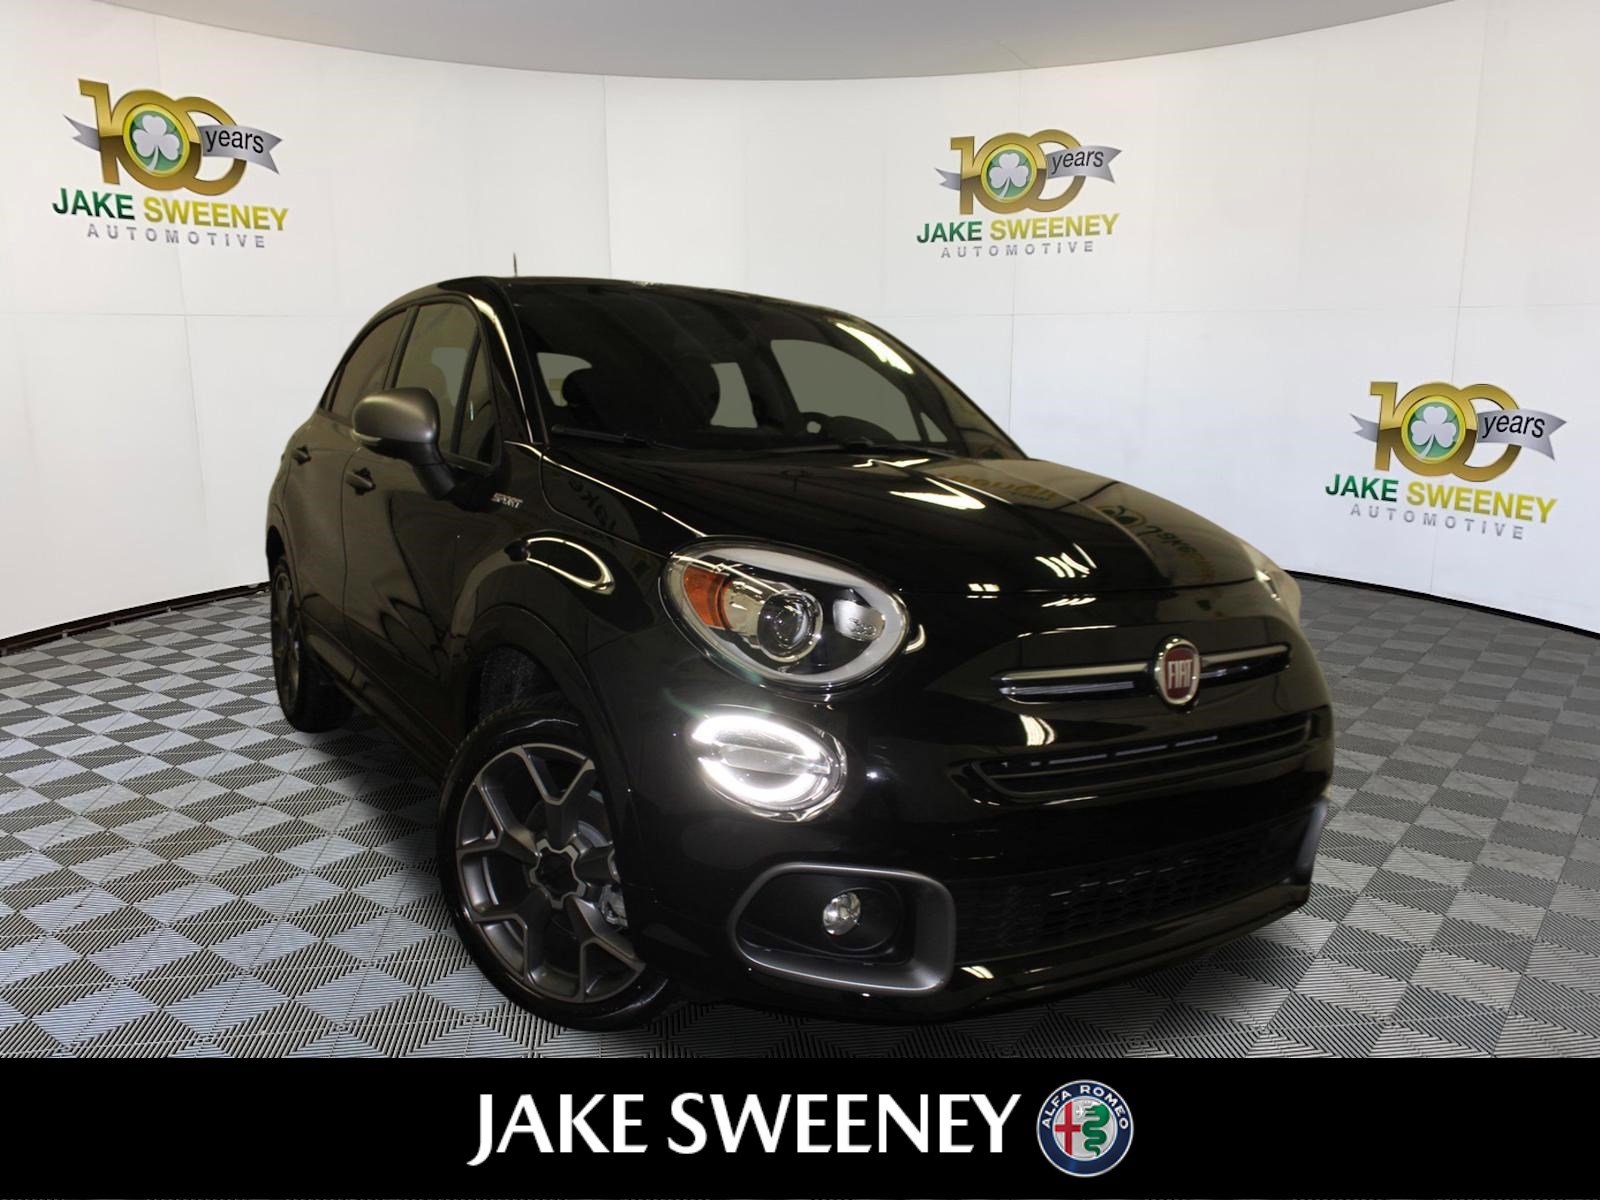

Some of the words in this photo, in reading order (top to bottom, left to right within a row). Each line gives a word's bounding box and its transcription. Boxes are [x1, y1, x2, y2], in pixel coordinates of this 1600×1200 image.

[78, 78, 247, 196] 100
[205, 130, 264, 153] years
[950, 129, 1087, 215] 100
[1052, 149, 1104, 175] years
[52, 187, 135, 220] JAKE
[143, 196, 288, 231] SWEENEY
[87, 223, 265, 248] AUTOMOTIVE
[917, 221, 983, 243] JAKE
[990, 213, 1120, 241] SWEENEY
[941, 241, 1094, 258] AUTOMOTIVE
[1370, 381, 1522, 482] 100
[1482, 414, 1546, 439] years
[1325, 474, 1399, 502] JAKE
[1406, 481, 1558, 523] SWEENEY
[1351, 503, 1524, 540] AUTOMOTIVE
[1168, 659, 1193, 689] FIAT
